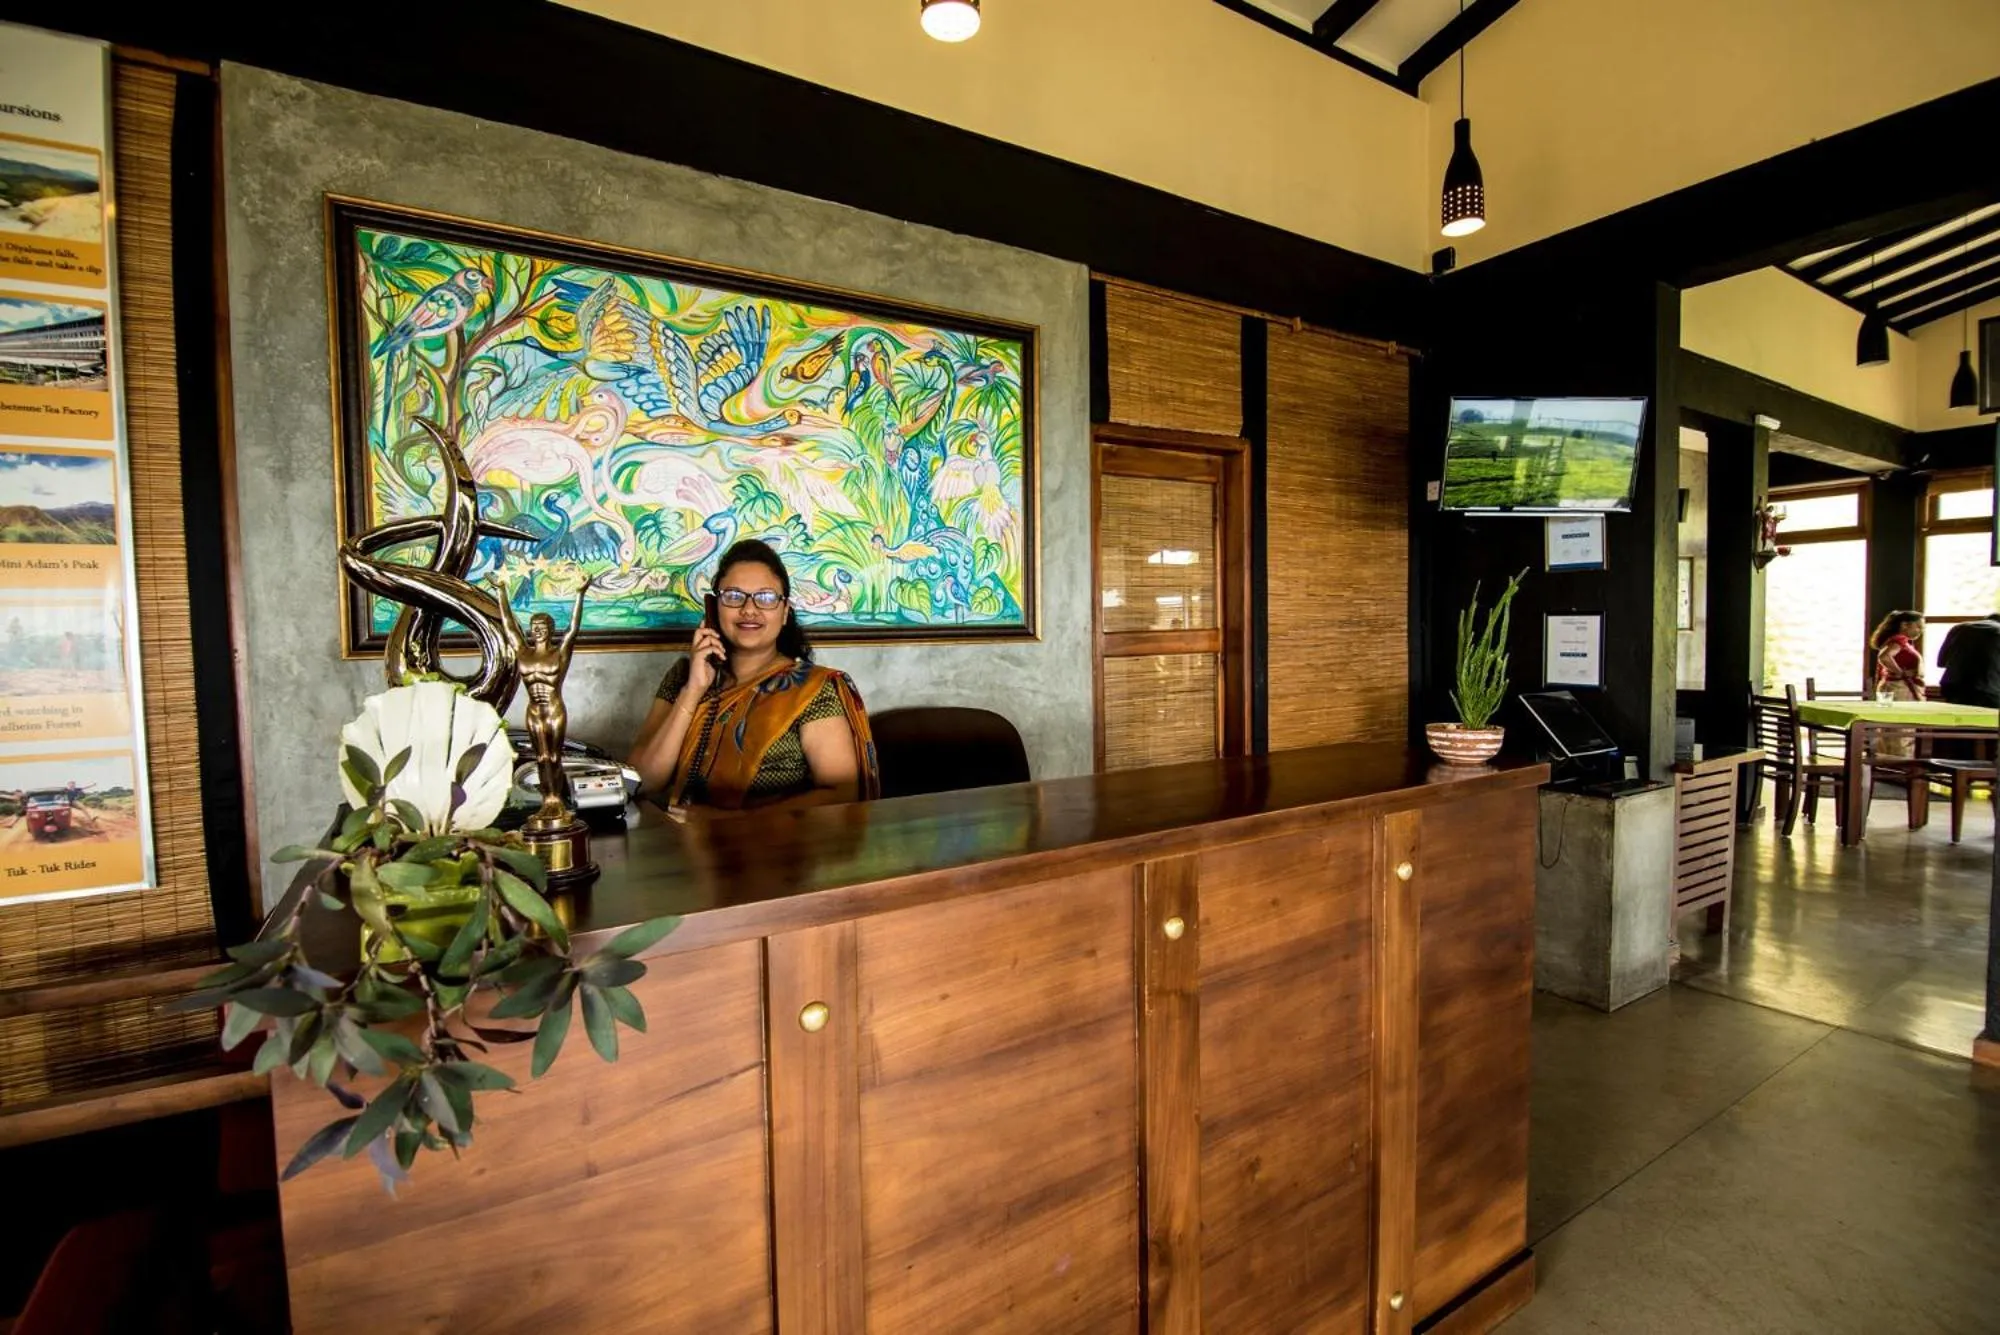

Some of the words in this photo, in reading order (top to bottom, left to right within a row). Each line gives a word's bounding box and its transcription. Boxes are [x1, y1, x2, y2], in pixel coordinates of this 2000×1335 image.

[35, 259, 53, 268] and
[42, 404, 60, 414] Tea
[62, 406, 99, 419] Factory
[24, 559, 69, 569] Adam's
[72, 559, 99, 569] Peak
[71, 705, 83, 714] in
[45, 720, 82, 730] Forest
[5, 866, 28, 877] Tuk
[38, 863, 61, 874] Tuk
[64, 860, 97, 871] Rides
